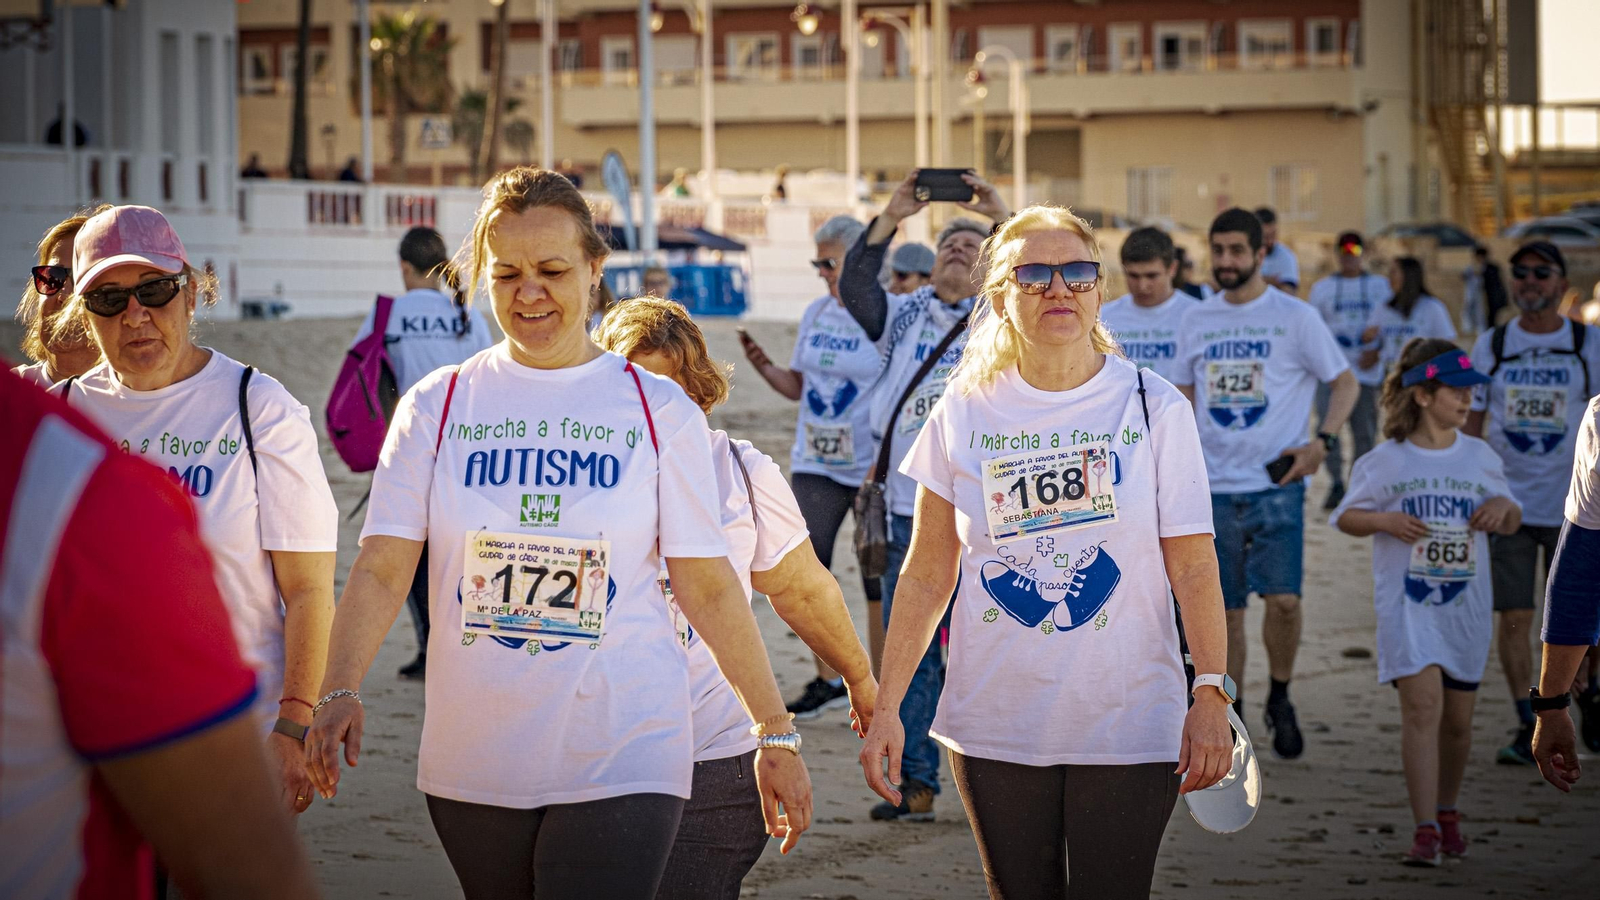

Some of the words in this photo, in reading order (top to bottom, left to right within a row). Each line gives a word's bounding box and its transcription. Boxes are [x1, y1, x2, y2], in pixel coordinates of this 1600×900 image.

[1203, 340, 1272, 360] AUTISMO
[1216, 374, 1253, 392] 425
[458, 417, 526, 442] marcha
[537, 419, 548, 438] a
[560, 417, 615, 444] favor
[980, 430, 1041, 451] marcha
[1050, 432, 1060, 449] a
[140, 438, 150, 454] a
[160, 432, 211, 457] favor
[464, 448, 620, 488] AUTISMO
[999, 460, 1025, 470] MARCHA
[1035, 455, 1056, 463] FAVOR
[1058, 452, 1069, 460] DEL
[1011, 467, 1086, 510] 168
[1003, 508, 1059, 524] SEBASTIANA
[1401, 494, 1475, 520] AUTISMO
[485, 540, 516, 550] MARCHA
[518, 542, 525, 550] A
[527, 543, 551, 554] FAVOR
[553, 546, 565, 555] DEL
[1427, 541, 1469, 563] 663
[997, 545, 1039, 581] Cada
[1038, 580, 1070, 598] paso
[1063, 540, 1107, 578] cuenta
[497, 563, 578, 609] 172
[490, 606, 505, 615] DE
[507, 607, 520, 617] LA
[522, 609, 542, 619] PAZ
